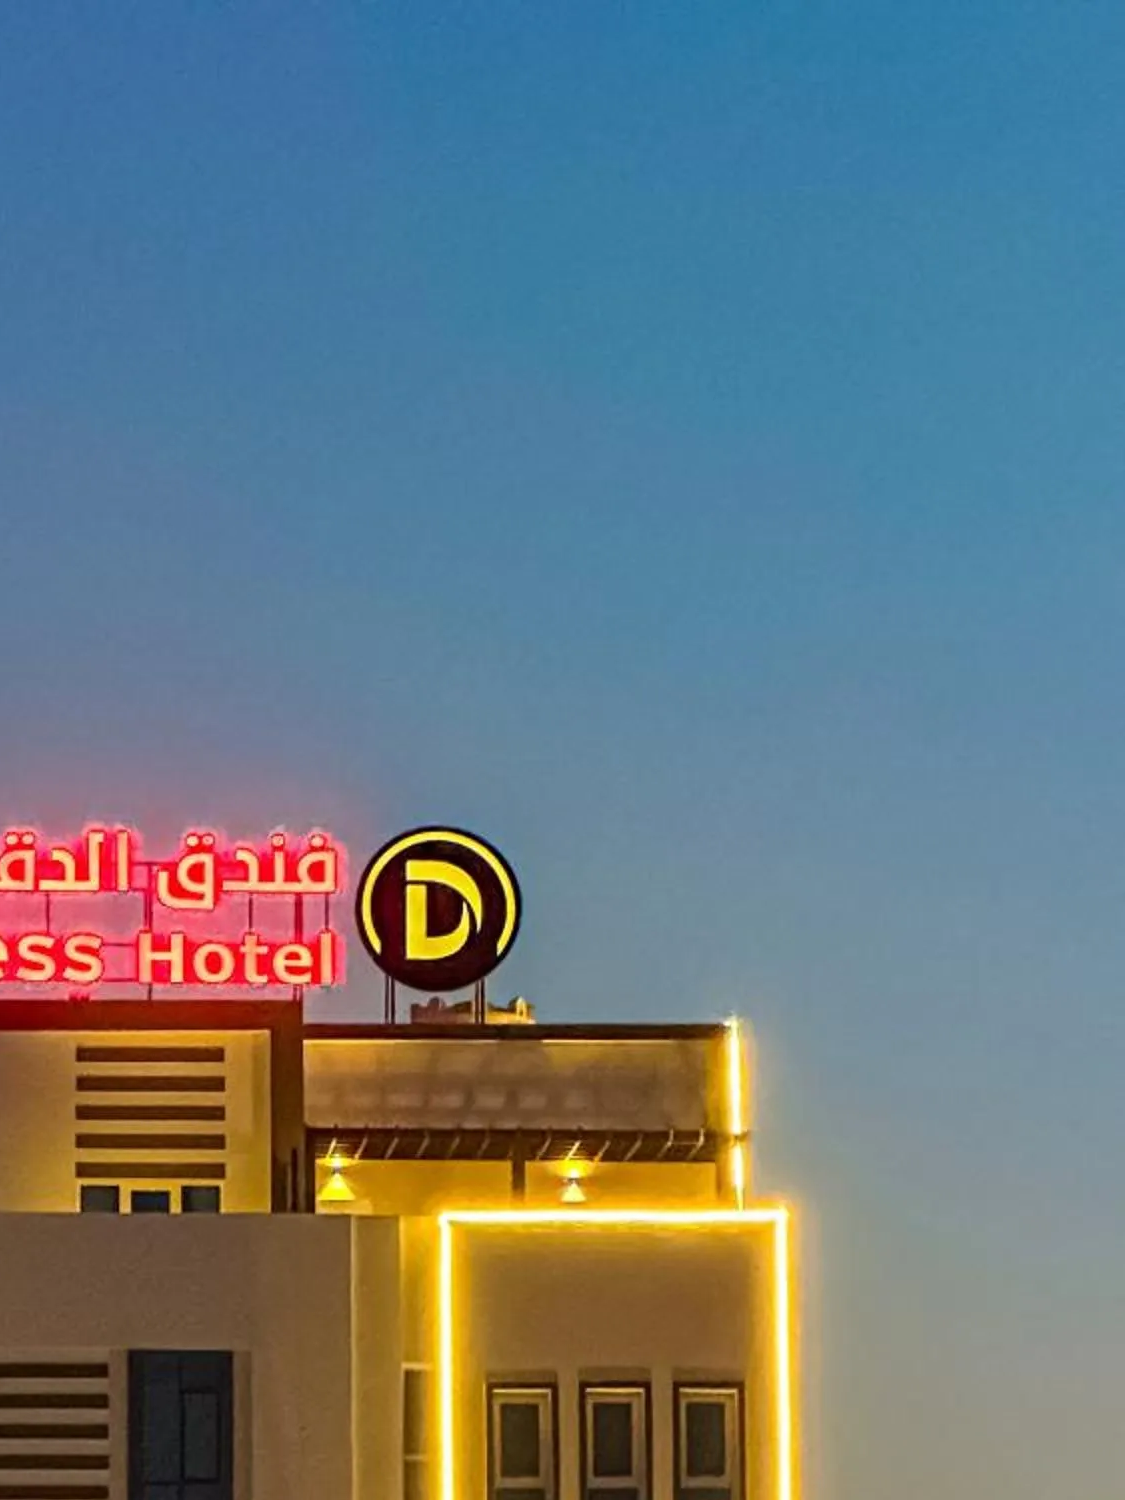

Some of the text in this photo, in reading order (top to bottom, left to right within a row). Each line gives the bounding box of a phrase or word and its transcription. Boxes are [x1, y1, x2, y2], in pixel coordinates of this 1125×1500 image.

[157, 829, 337, 910] فندق
[405, 858, 483, 961] D
[138, 928, 335, 986] Hotel
